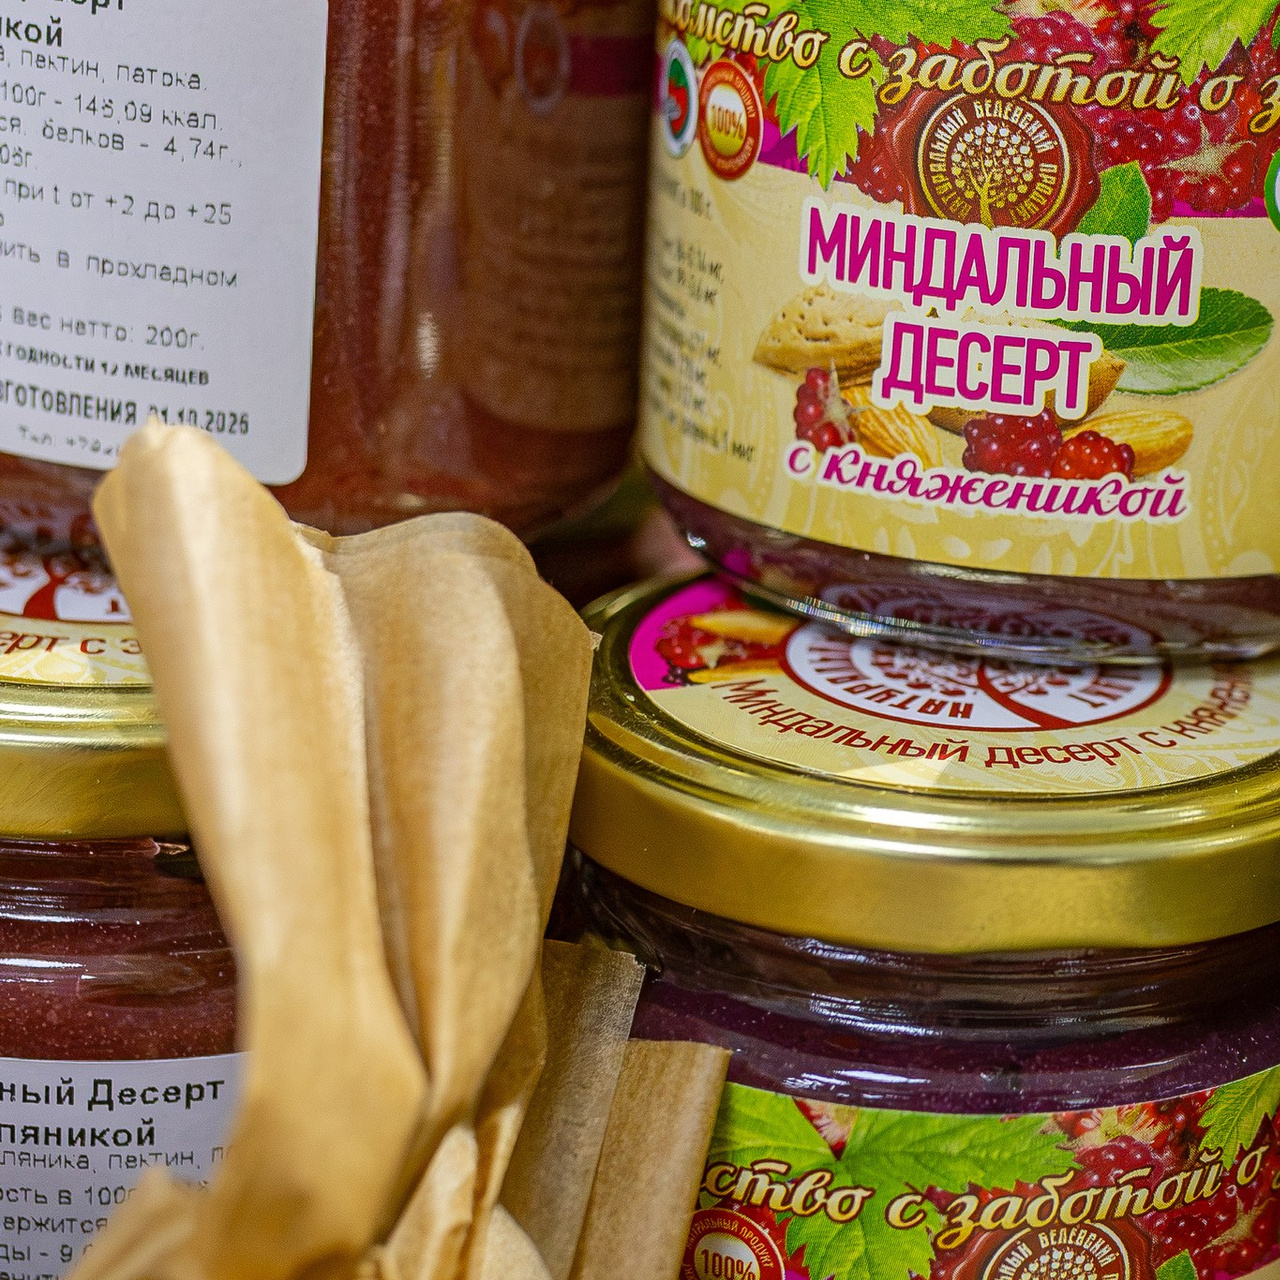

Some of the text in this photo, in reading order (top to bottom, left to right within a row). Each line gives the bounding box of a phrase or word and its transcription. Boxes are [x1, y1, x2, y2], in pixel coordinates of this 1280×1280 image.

[0, 15, 63, 47] кой
[21, 49, 208, 91] пектин, патока.
[839, 37, 1243, 114] с заботой о
[42, 119, 125, 151] белков
[162, 109, 224, 132] ккал.
[5, 179, 44, 201] при
[70, 192, 94, 209] от
[144, 201, 176, 222] до
[188, 203, 232, 225] +25
[57, 250, 238, 288] в прохладном
[807, 205, 1194, 318] МИНДАЛЬНЫЙ
[61, 317, 133, 343] нетто:
[146, 326, 205, 351] 200г.
[124, 362, 210, 387] МЕСЯЦЕВ
[881, 321, 1092, 410] ДЕСЕРТ
[0, 378, 138, 425] ГОТОВЛЕНИЯ
[788, 445, 1188, 518] с княженикой
[710, 678, 970, 763] Миндальный
[984, 736, 1142, 769] десерт
[87, 1078, 226, 1112] Десерт
[58, 1189, 72, 1206] в
[885, 1192, 926, 1228] с
[936, 1151, 1223, 1249] заботой
[1232, 1146, 1270, 1189] о
